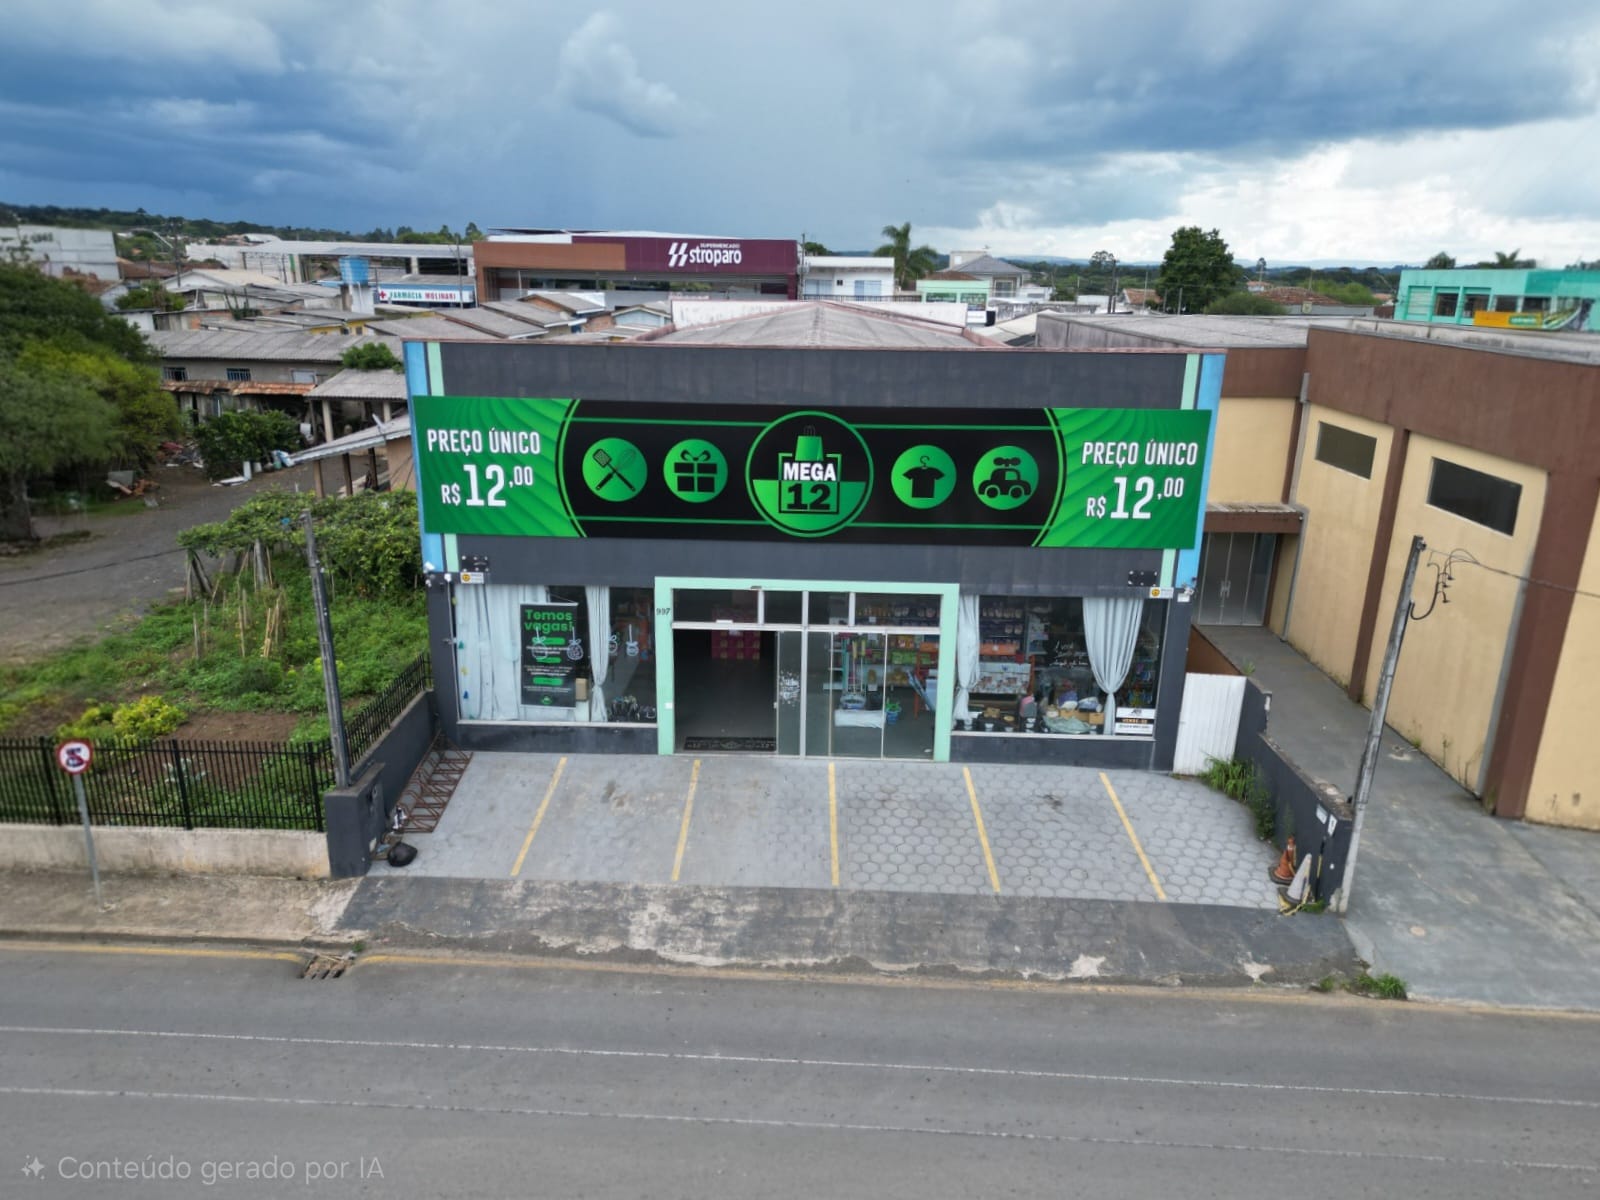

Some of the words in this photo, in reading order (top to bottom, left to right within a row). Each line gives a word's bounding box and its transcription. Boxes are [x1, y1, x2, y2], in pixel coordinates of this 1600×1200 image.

[689, 245, 742, 267] stroparo
[424, 291, 456, 300] MOLINARI
[427, 428, 483, 456] PREÇO
[488, 427, 541, 455] ÚNICO
[1082, 441, 1139, 468] PREÇO
[1144, 438, 1198, 466] ÚNICO
[783, 462, 837, 482] MEGA
[787, 483, 831, 511] 12
[524, 608, 573, 621] Temos
[524, 620, 574, 634] vagas!
